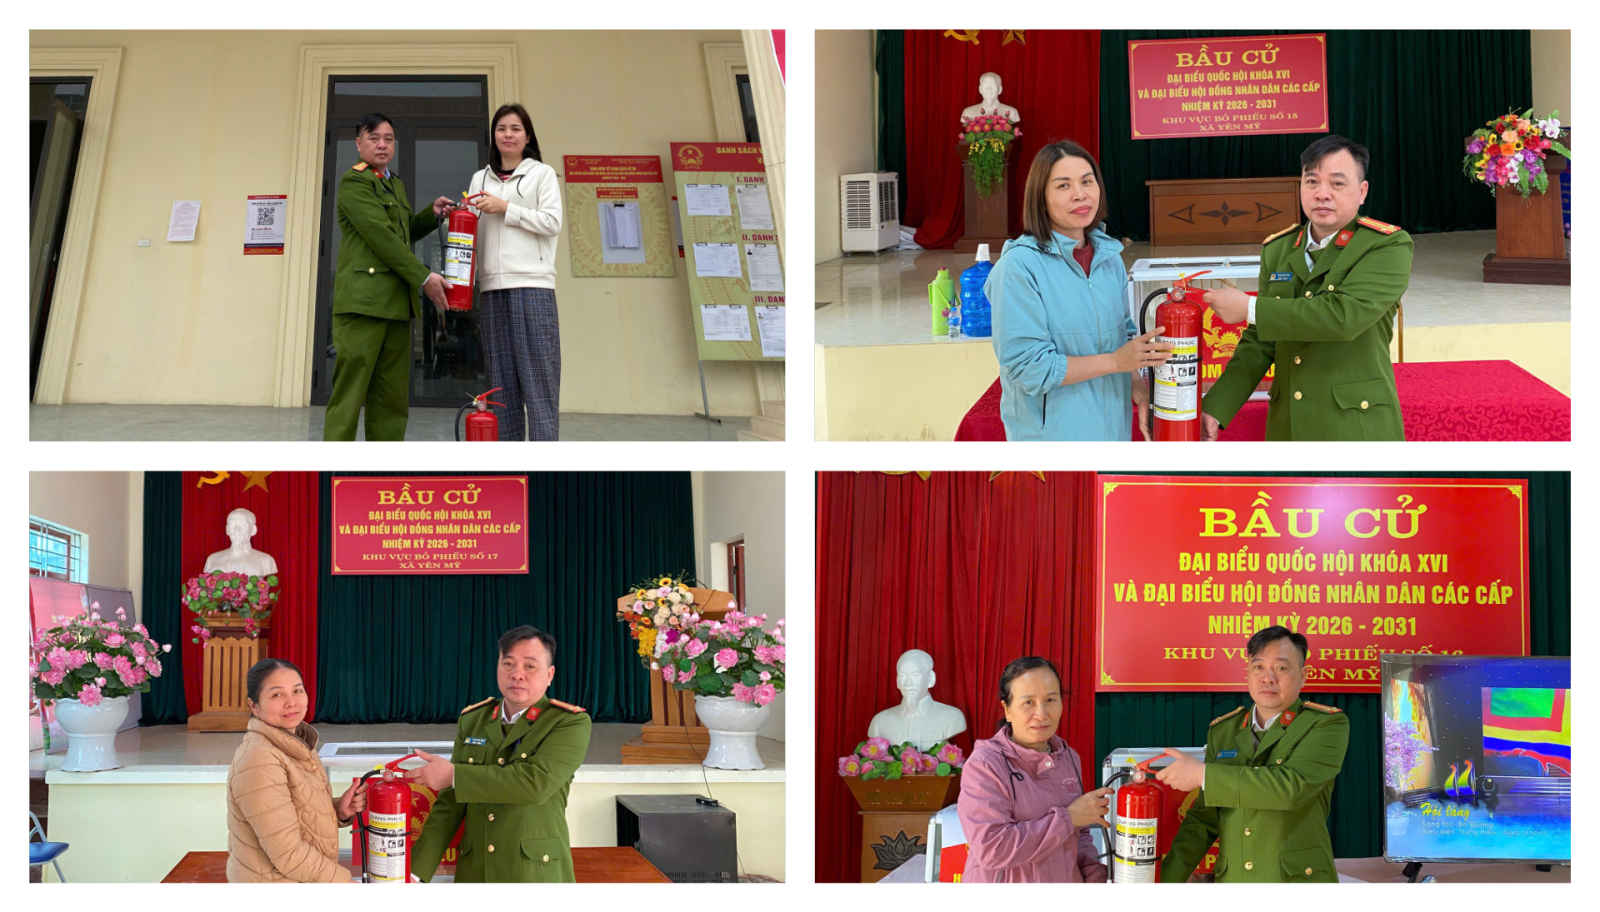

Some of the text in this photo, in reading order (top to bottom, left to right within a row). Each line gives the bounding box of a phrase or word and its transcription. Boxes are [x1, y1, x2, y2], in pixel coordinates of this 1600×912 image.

[1175, 43, 1280, 67] BẦU CỬ
[1167, 69, 1290, 85] ĐẠI BIỂU QUỐC HỘI KHÓA XVI
[1138, 80, 1320, 100] VÀ ĐẠI BIỂU HỘI ĐỒNG NHÂN DÂN CÁC CẤP
[1182, 100, 1210, 113] NHIỆM
[1213, 99, 1224, 110] KỲ
[1226, 100, 1248, 110] 2026
[1256, 99, 1276, 108] 2031
[1189, 116, 1211, 124] VỰC
[1215, 113, 1229, 122] BỎ
[1233, 112, 1266, 121] PHIẾU
[1270, 111, 1284, 120] SỐ
[1218, 122, 1240, 130] YÊN
[738, 146, 757, 154] SÁCH
[378, 483, 482, 504] BẦU CỬ
[369, 508, 491, 522] ĐẠI BIỂU QUỐC HỘI KHÓA XVI
[1199, 491, 1428, 539] BẦU CỬ
[340, 521, 521, 536] VÀ ĐẠI BIỂU HỘI ĐỒNG NHÂN DÂN CÁC CẤP
[382, 538, 411, 550] NHIỆM
[414, 537, 424, 548] KỲ
[427, 539, 448, 548] 2026
[456, 539, 477, 548] 2031
[389, 553, 412, 562] VỰC
[415, 552, 430, 560] BỎ
[433, 551, 467, 560] PHIẾU
[470, 551, 484, 560] SỐ
[1179, 545, 1448, 576] ĐẠI BIỂU QUỐC HỘI KHÓA XVI
[1114, 576, 1513, 607] VÀ ĐẠI BIỂU HỘI ĐỒNG NHÂN DÂN CÁC CẤP
[1208, 612, 1270, 638] NHIỆM
[1277, 612, 1300, 634] KỲ
[1306, 616, 1352, 635] 2026
[1372, 617, 1416, 636] 2031
[1164, 648, 1216, 659] KHU
[1343, 666, 1380, 680] MỸ
[1420, 802, 1470, 821] Hội làng
